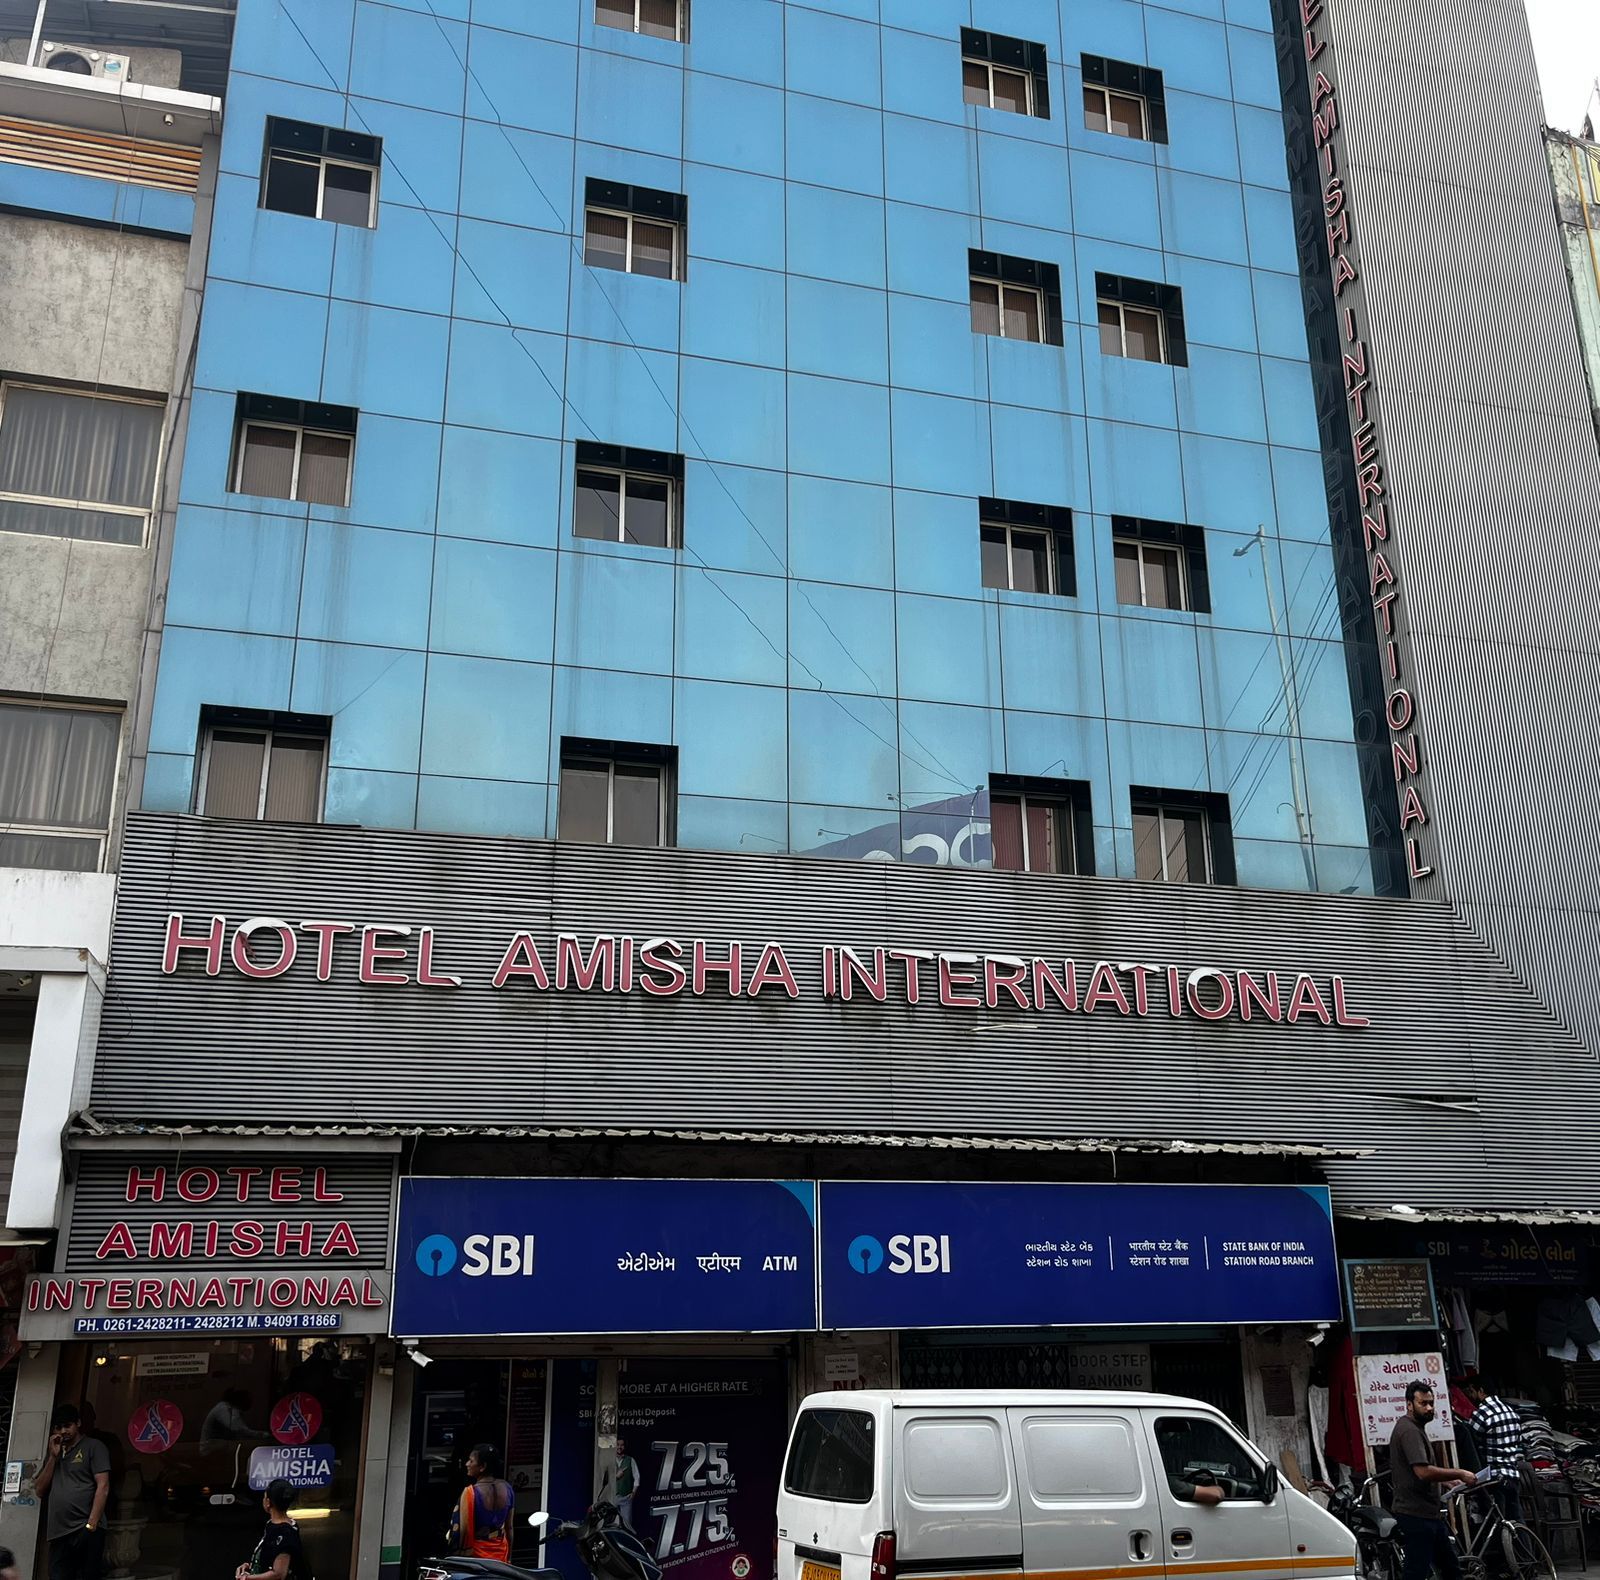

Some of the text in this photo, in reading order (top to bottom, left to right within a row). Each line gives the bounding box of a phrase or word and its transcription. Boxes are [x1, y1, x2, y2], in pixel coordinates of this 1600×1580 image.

[1312, 71, 1356, 297] AMISHA
[1343, 307, 1433, 879] INTERNATIONAL
[161, 911, 1371, 1027] HOTEL AMISHA INTERNATIONAL
[125, 1166, 344, 1202] HOTEL
[95, 1220, 361, 1259] AMISHA
[1128, 1240, 1156, 1251] भारतीय
[1157, 1240, 1172, 1251] स्टेट
[1222, 1242, 1305, 1251] STATE BANK OF INDIA
[461, 1234, 534, 1276] SBI
[888, 1234, 950, 1274] SBI
[1428, 1241, 1450, 1256] SBI
[617, 1252, 675, 1271] એટીએમ
[696, 1252, 741, 1272] एटीएम
[762, 1256, 797, 1271] ATM
[1129, 1254, 1151, 1266] स्टेशन
[1224, 1256, 1314, 1266] STATION ROAD BRANCH
[27, 1276, 384, 1312] INTERNATIONAL
[77, 1318, 99, 1331] PH.
[194, 1316, 243, 1329] 2428212
[247, 1316, 260, 1328] M.
[264, 1315, 298, 1328] 94091
[302, 1314, 337, 1327] 81866
[1070, 1353, 1148, 1367] DOOR STEP
[1383, 1359, 1420, 1374] ચેતવણી
[619, 1381, 748, 1393] MORE AT A HIGHER RATE
[1078, 1373, 1143, 1387] BANKING
[579, 1409, 592, 1418] SBI
[645, 1407, 676, 1417] Deposit
[620, 1417, 654, 1427] 444 days
[272, 1447, 314, 1459] HOTEL
[251, 1459, 331, 1479] AMISHA
[256, 1477, 325, 1488] INTATIONAL
[671, 1491, 700, 1500] CUSTOMERS
[700, 1488, 727, 1496] INCLUDING
[663, 1557, 686, 1569] RESIDENT
[686, 1551, 705, 1562] SENIOR
[705, 1545, 726, 1556] CITIZENS
[726, 1541, 739, 1551] ONLY
